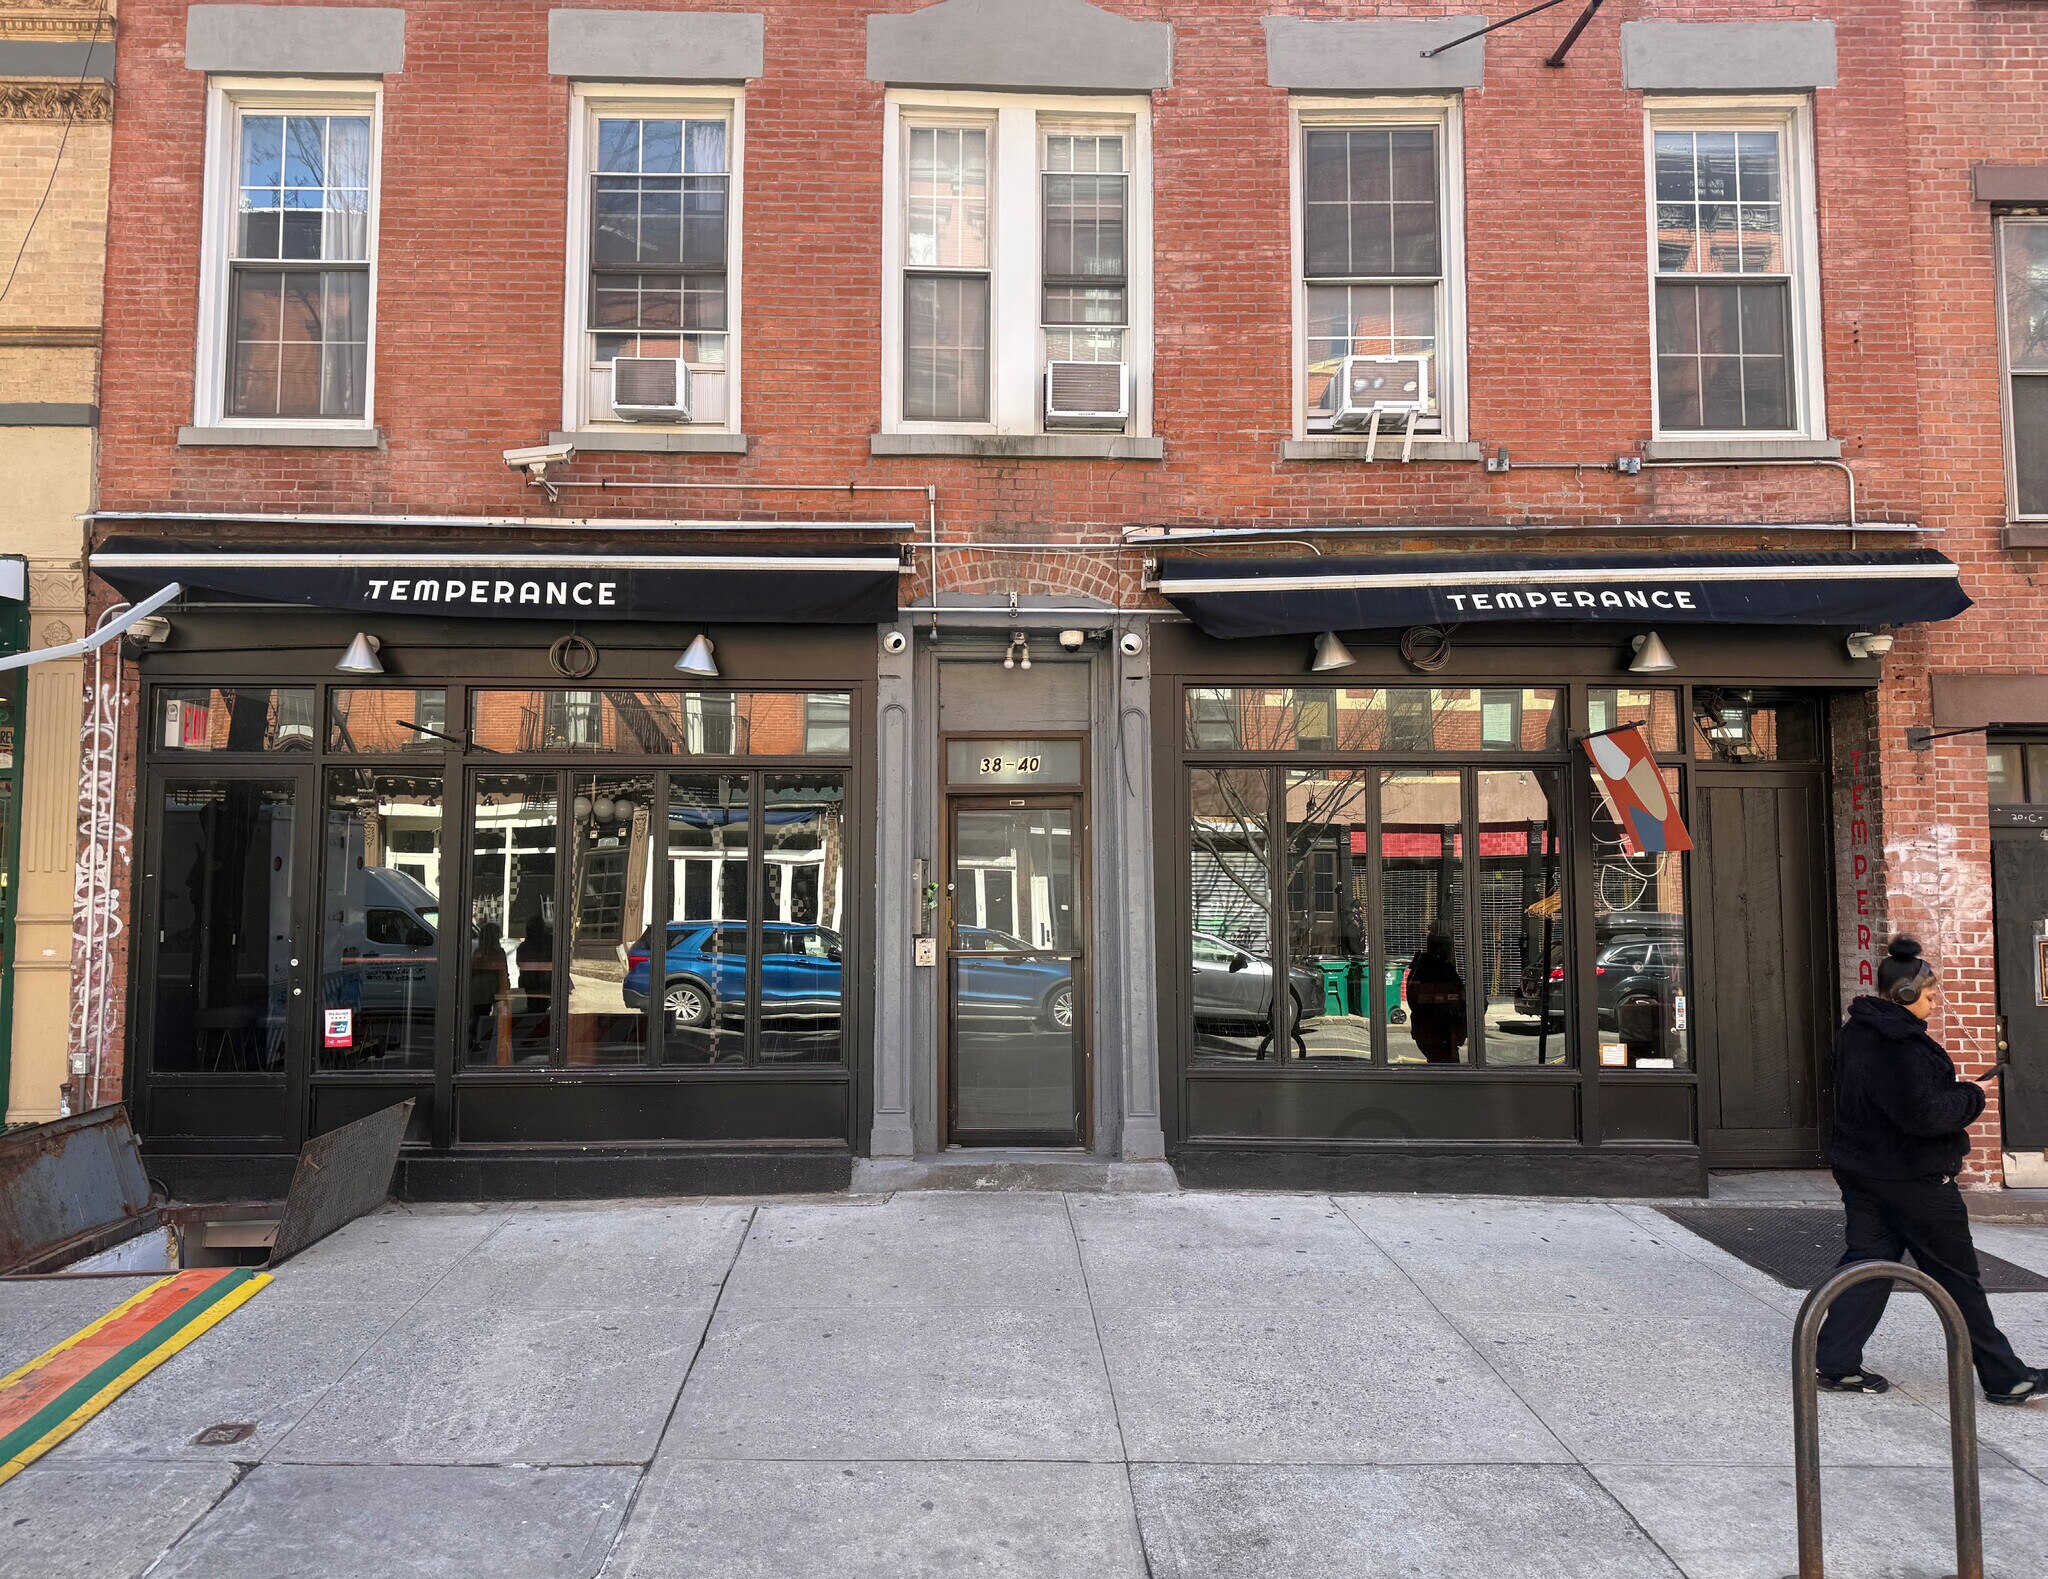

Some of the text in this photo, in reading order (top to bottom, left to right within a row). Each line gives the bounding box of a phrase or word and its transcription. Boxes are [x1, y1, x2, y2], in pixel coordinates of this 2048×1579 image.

[367, 579, 617, 606] TEMPERANCE
[1446, 590, 1698, 611] TEMPERANCE
[981, 757, 1039, 773] 38-40
[1850, 750, 1873, 998] TEMPERA
